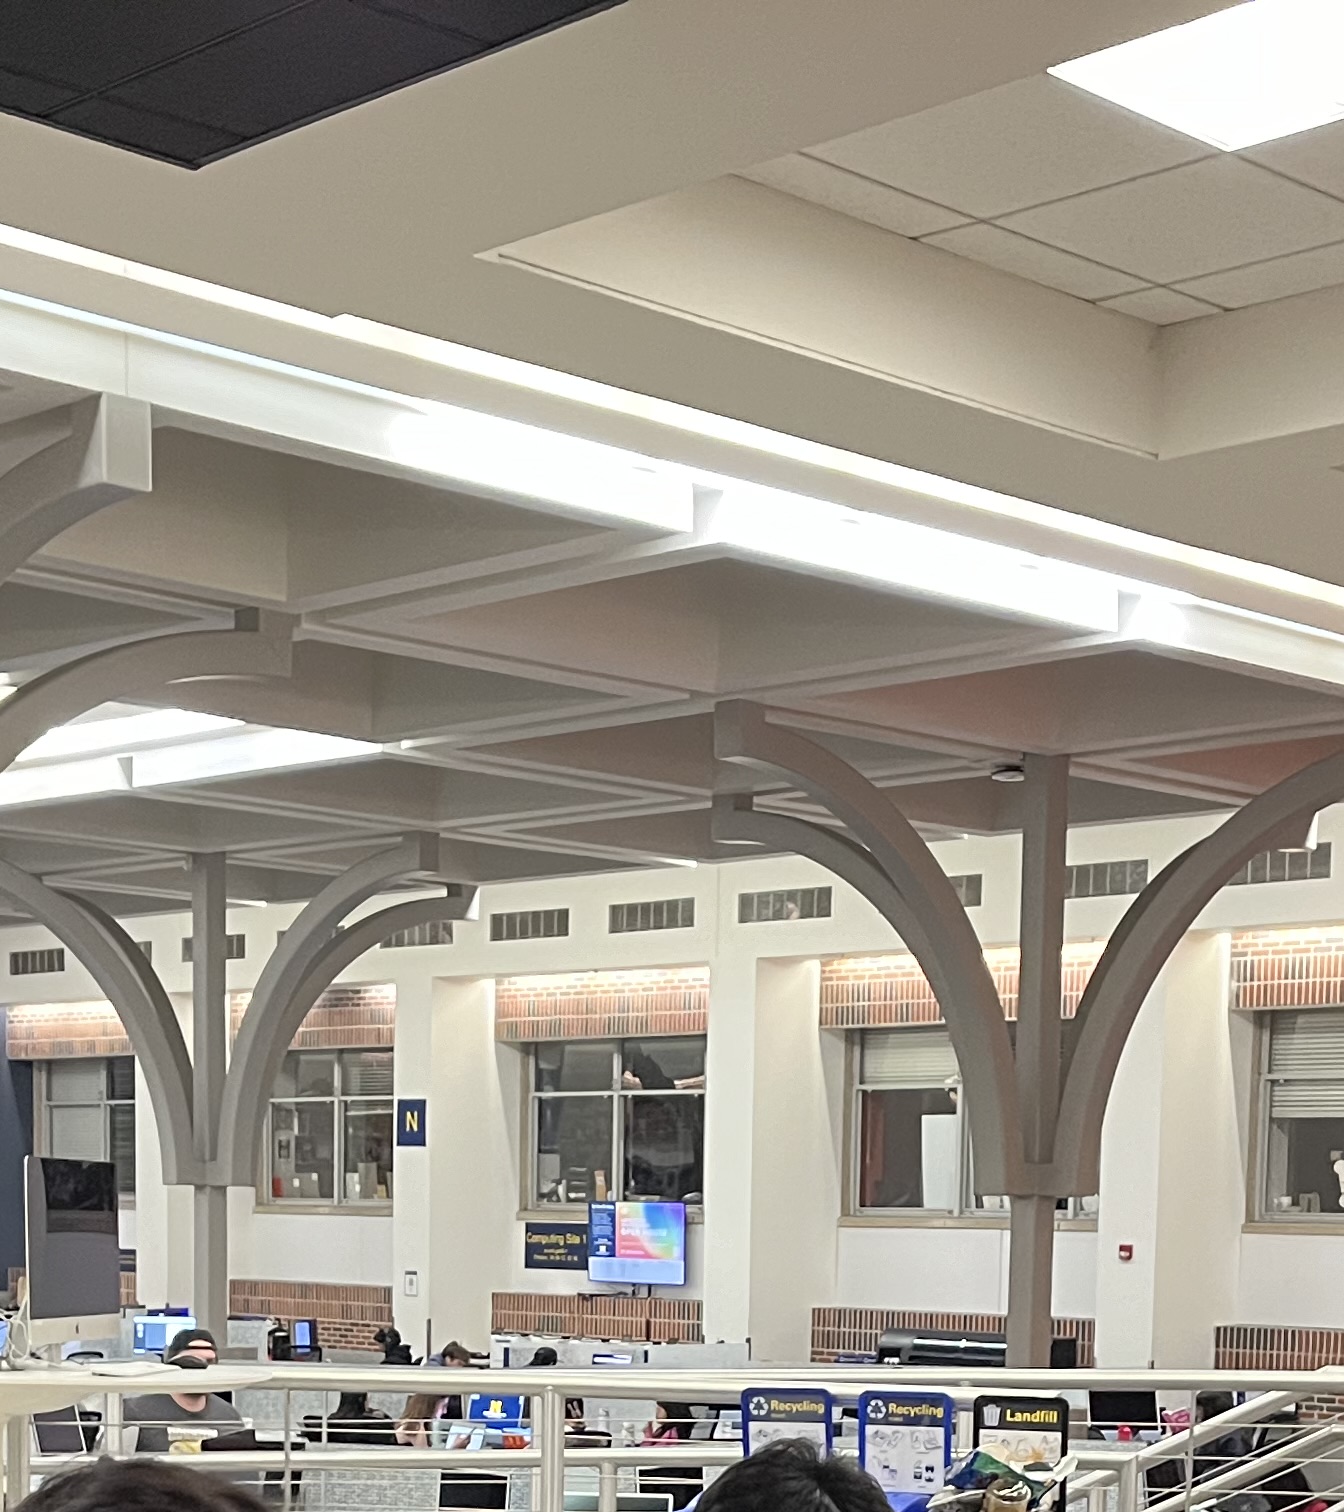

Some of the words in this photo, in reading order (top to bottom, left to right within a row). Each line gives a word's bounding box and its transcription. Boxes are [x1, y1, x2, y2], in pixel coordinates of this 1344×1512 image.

[406, 1110, 418, 1132] N
[526, 1231, 565, 1246] Computing
[566, 1232, 581, 1245] Site
[770, 1399, 825, 1415] Recycling
[888, 1402, 944, 1418] Recycling
[1006, 1408, 1058, 1424] Landfill
